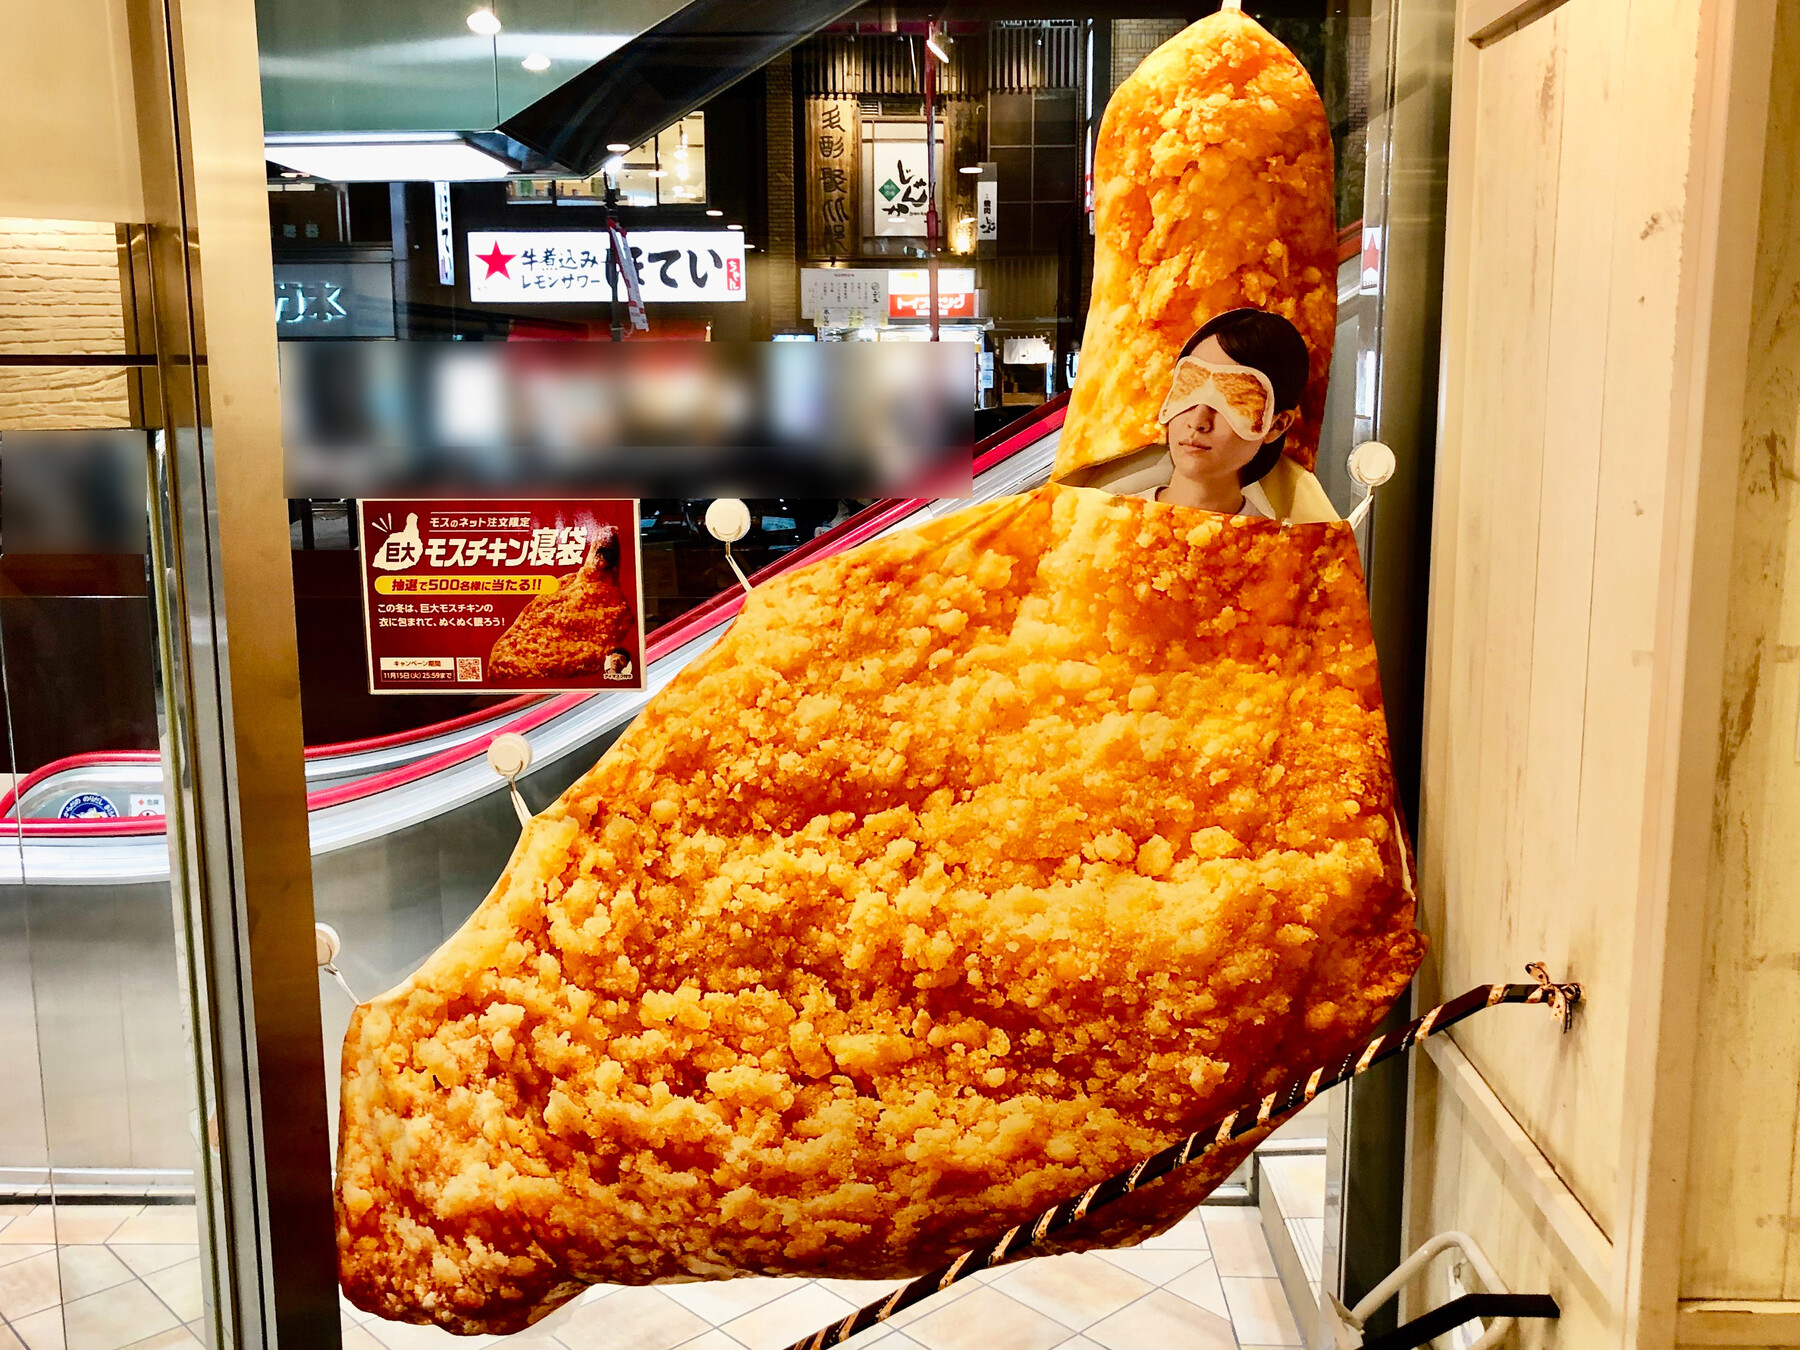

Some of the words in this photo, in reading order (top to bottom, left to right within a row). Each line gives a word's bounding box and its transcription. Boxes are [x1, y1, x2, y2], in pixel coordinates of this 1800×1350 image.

[521, 247, 598, 271] 牛煮込み
[521, 273, 600, 289] レモンサワー
[728, 259, 740, 290] ちゃん
[429, 517, 531, 528] モスのネット注文限定
[385, 541, 416, 563] 巨大
[425, 527, 587, 567] モスチキン寝袋
[391, 578, 542, 592] 抽選で500名様に当たる!!
[377, 603, 493, 614] この冬は、巨大モスチキンの
